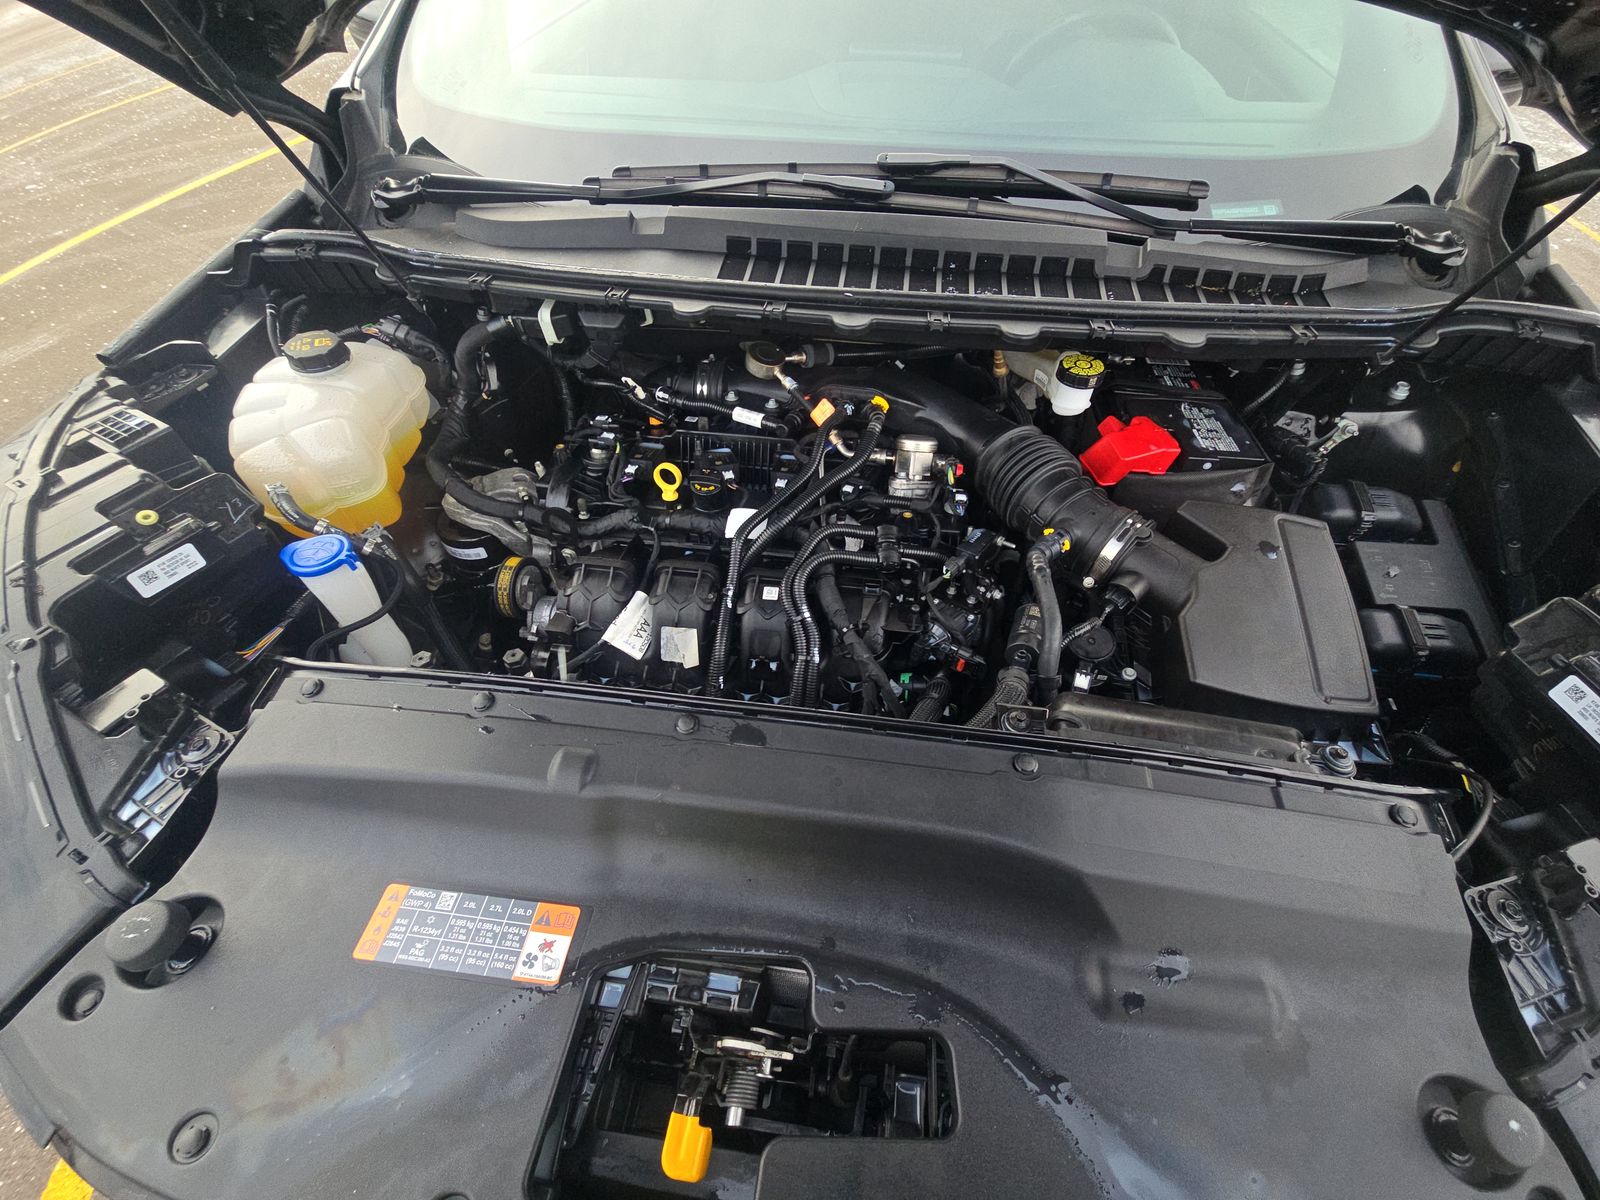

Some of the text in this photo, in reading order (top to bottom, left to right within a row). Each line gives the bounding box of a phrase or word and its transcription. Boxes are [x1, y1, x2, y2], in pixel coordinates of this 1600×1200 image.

[633, 618, 651, 639] AAA
[409, 889, 436, 898] FoMoCo
[402, 899, 424, 908] (GWP
[463, 901, 477, 909] 2.0L
[489, 904, 503, 913] 2.7L
[512, 907, 526, 916] 2.0L
[450, 918, 475, 929] 0.595 kg
[477, 922, 501, 933] 0.595 kg
[412, 925, 442, 936] R-1234yf
[503, 925, 528, 937] 0.454 kg
[409, 948, 425, 956] PAG
